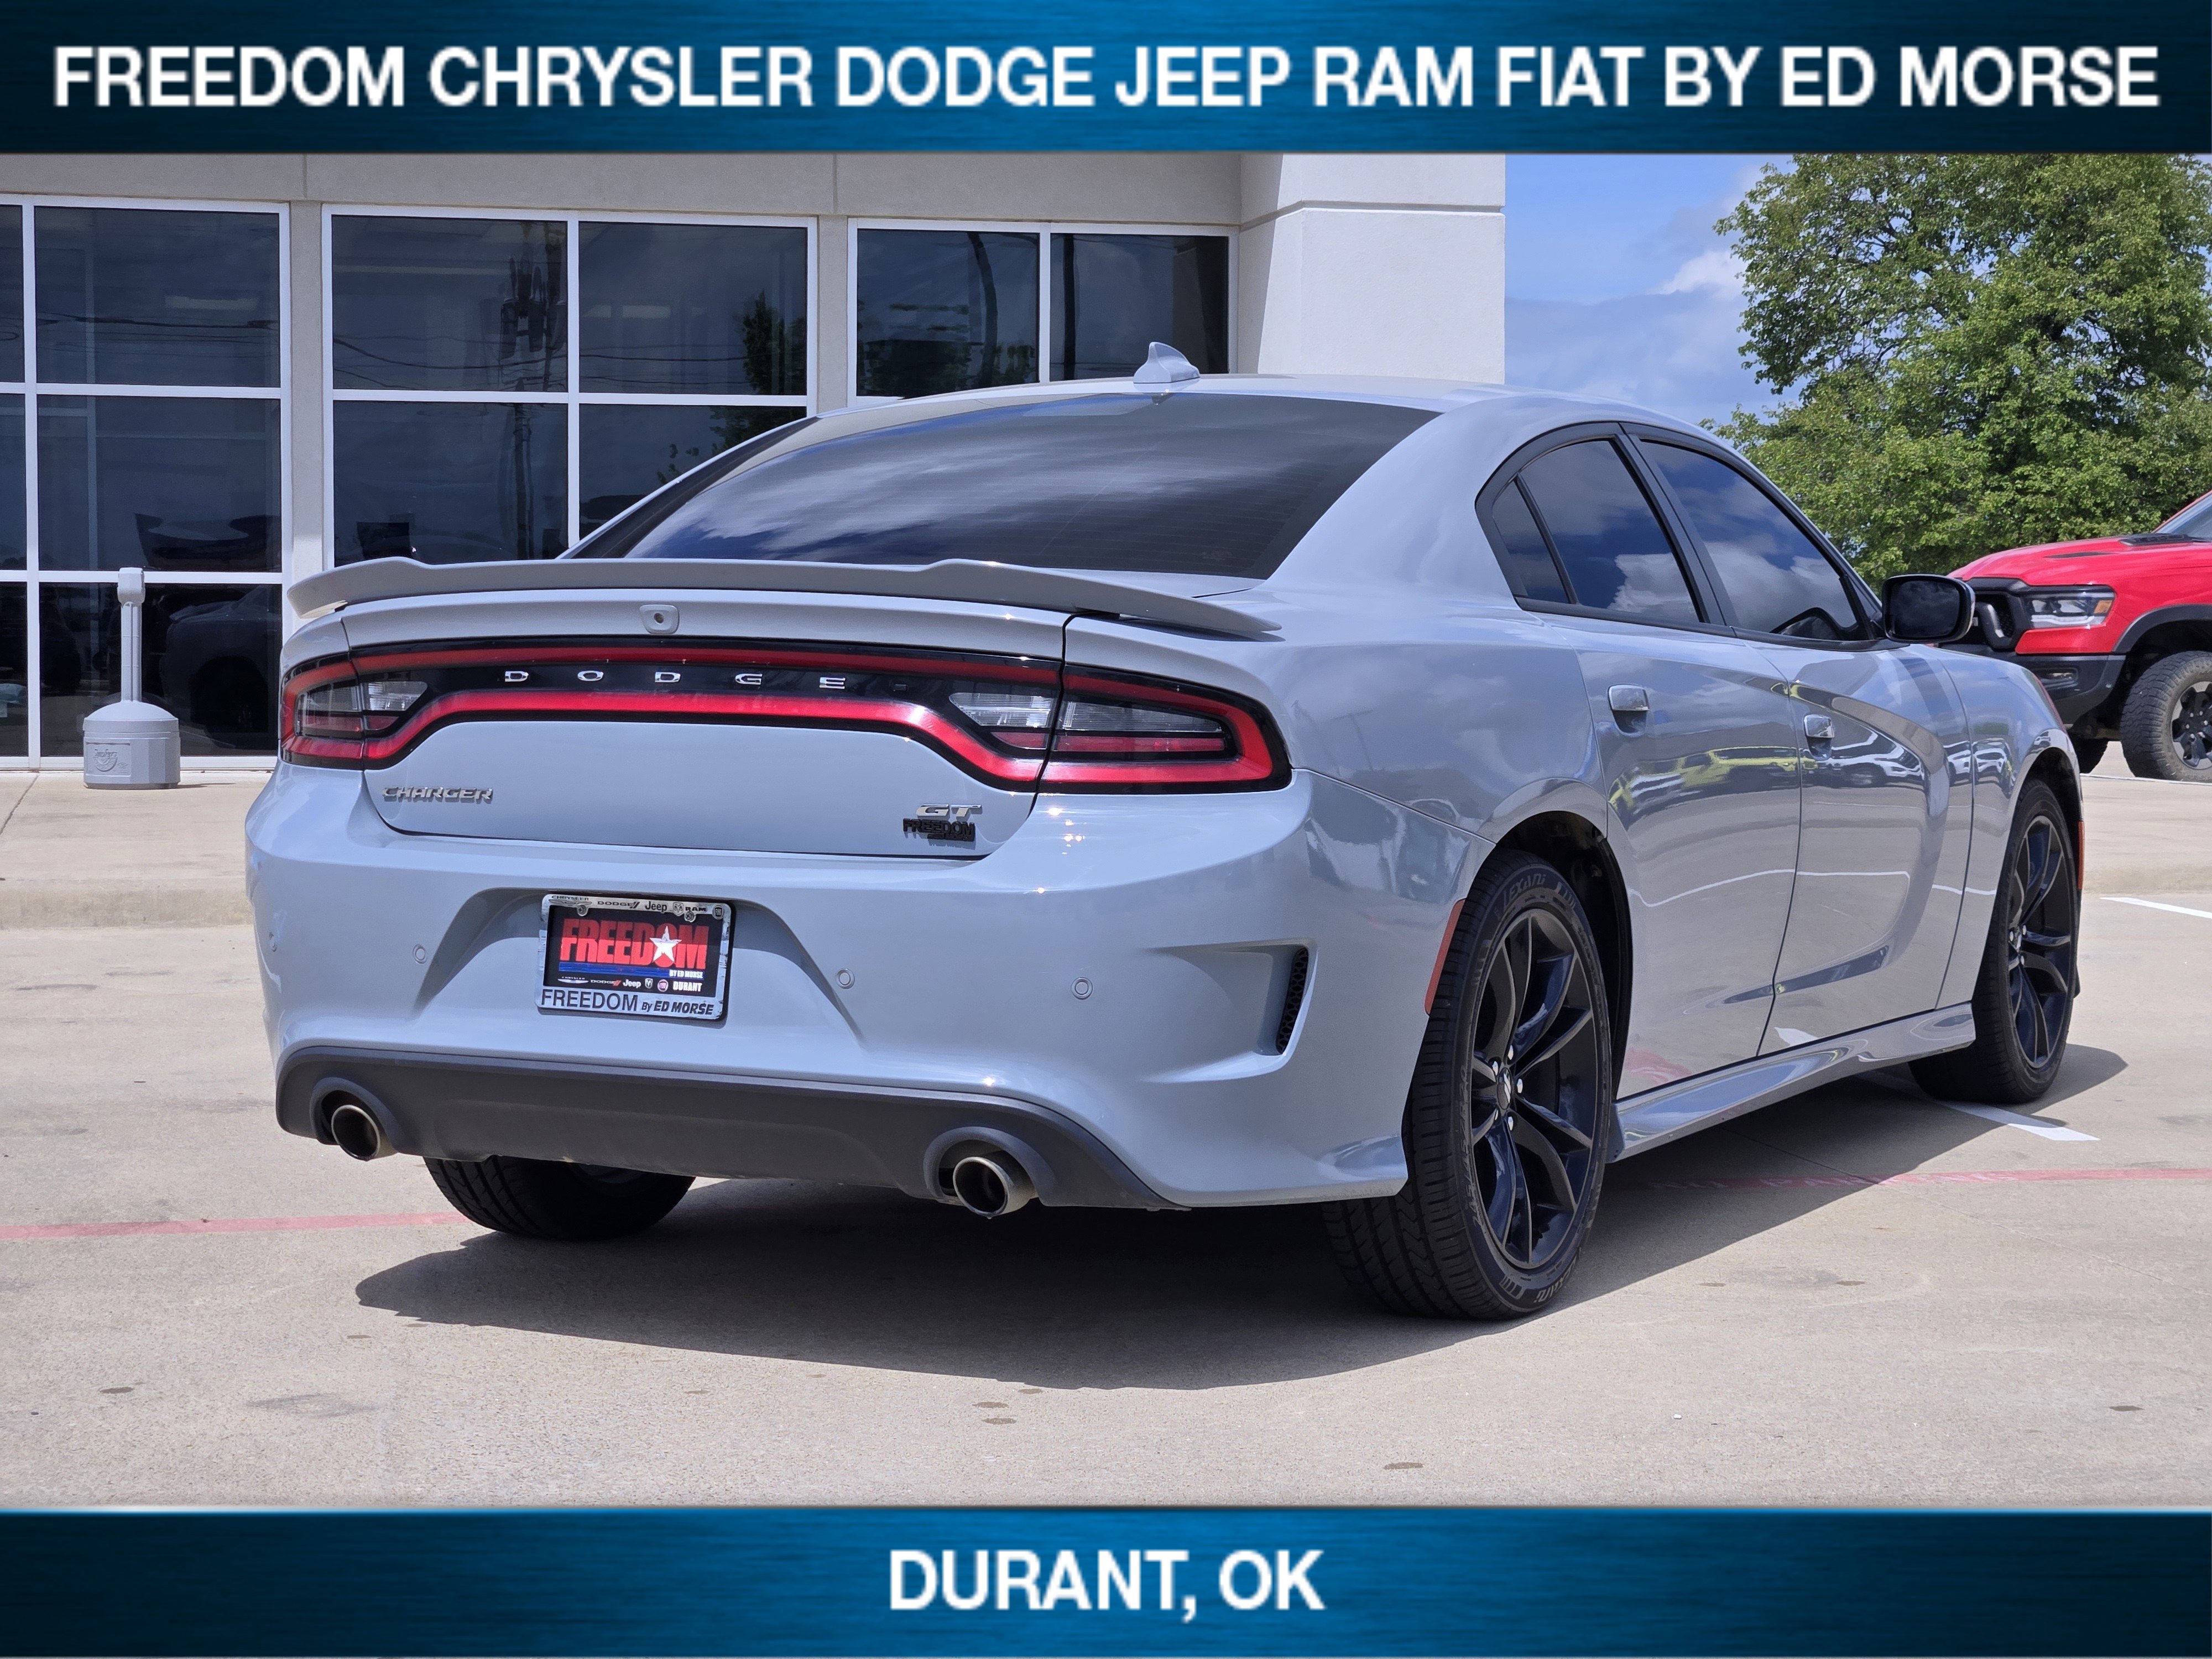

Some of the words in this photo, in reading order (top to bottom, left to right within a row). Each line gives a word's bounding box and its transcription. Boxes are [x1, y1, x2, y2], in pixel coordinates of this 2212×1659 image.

[504, 670, 846, 689] DODGE
[383, 786, 493, 801] CHARGER
[916, 804, 983, 820] GT
[903, 818, 975, 836] FREEDOM
[645, 901, 667, 912] Jeep
[559, 918, 709, 969] FREEDOM
[623, 979, 641, 988] Jeep
[672, 980, 702, 992] DURANT
[541, 989, 638, 1011] FREEDOM
[654, 1000, 670, 1012] ED
[671, 1002, 714, 1015] MORSE
